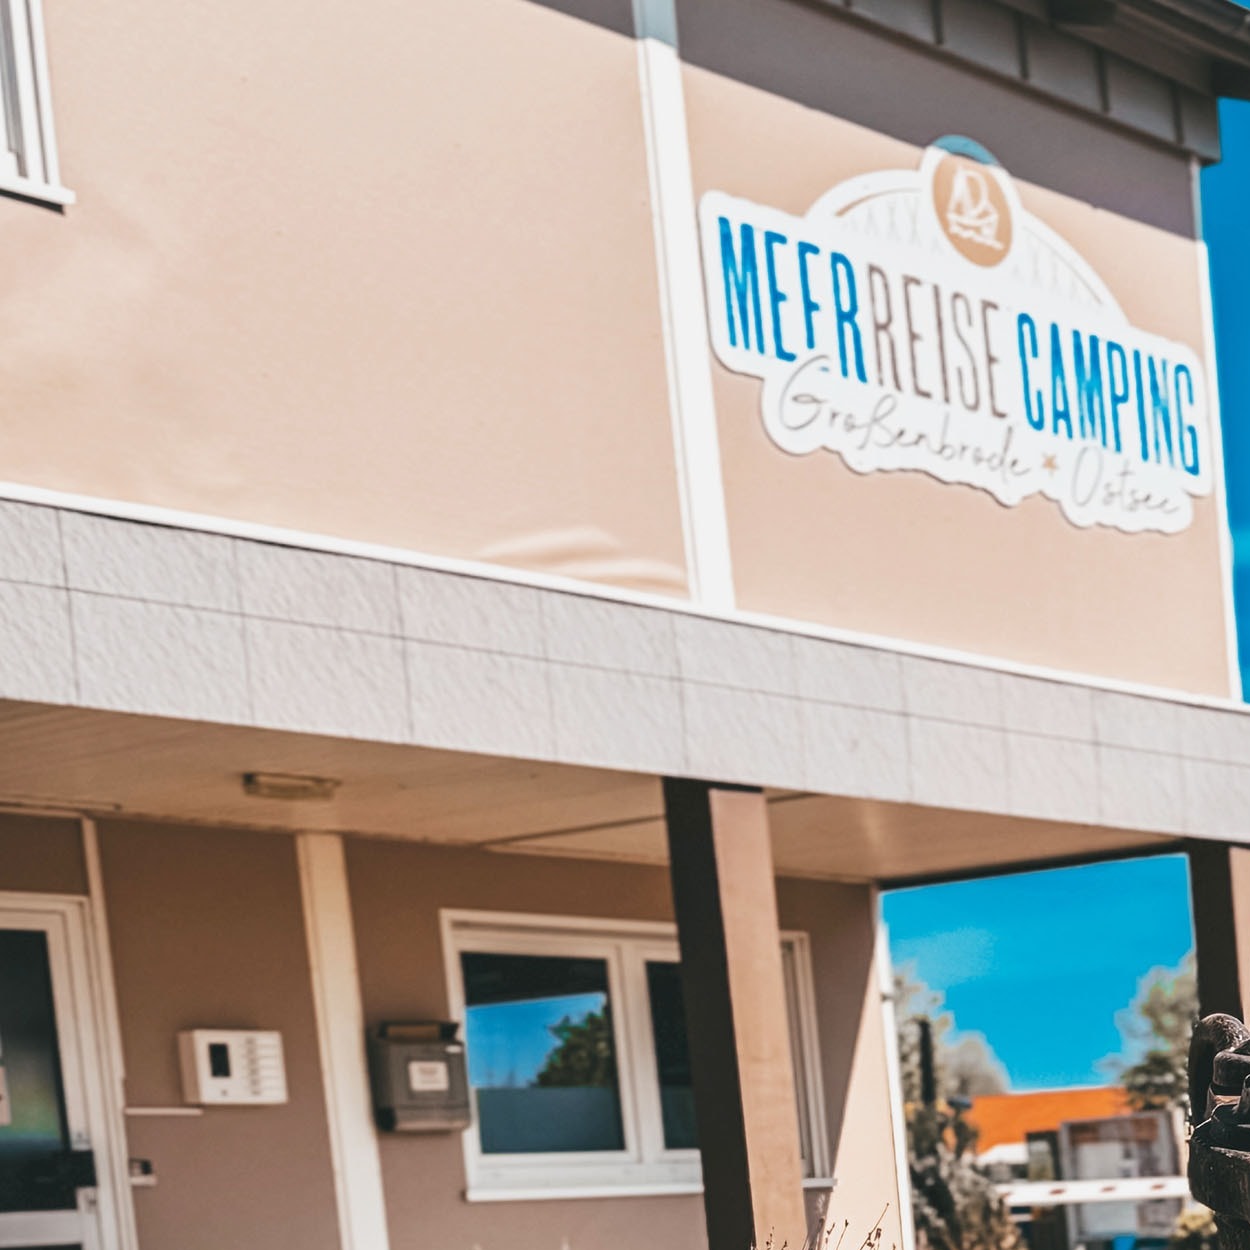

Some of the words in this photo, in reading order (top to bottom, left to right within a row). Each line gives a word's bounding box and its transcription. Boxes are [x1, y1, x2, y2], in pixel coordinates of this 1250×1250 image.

[778, 353, 1031, 483] Großenbrode
[1069, 446, 1181, 513] Ostsee
[1016, 312, 1200, 476] CAMPING
